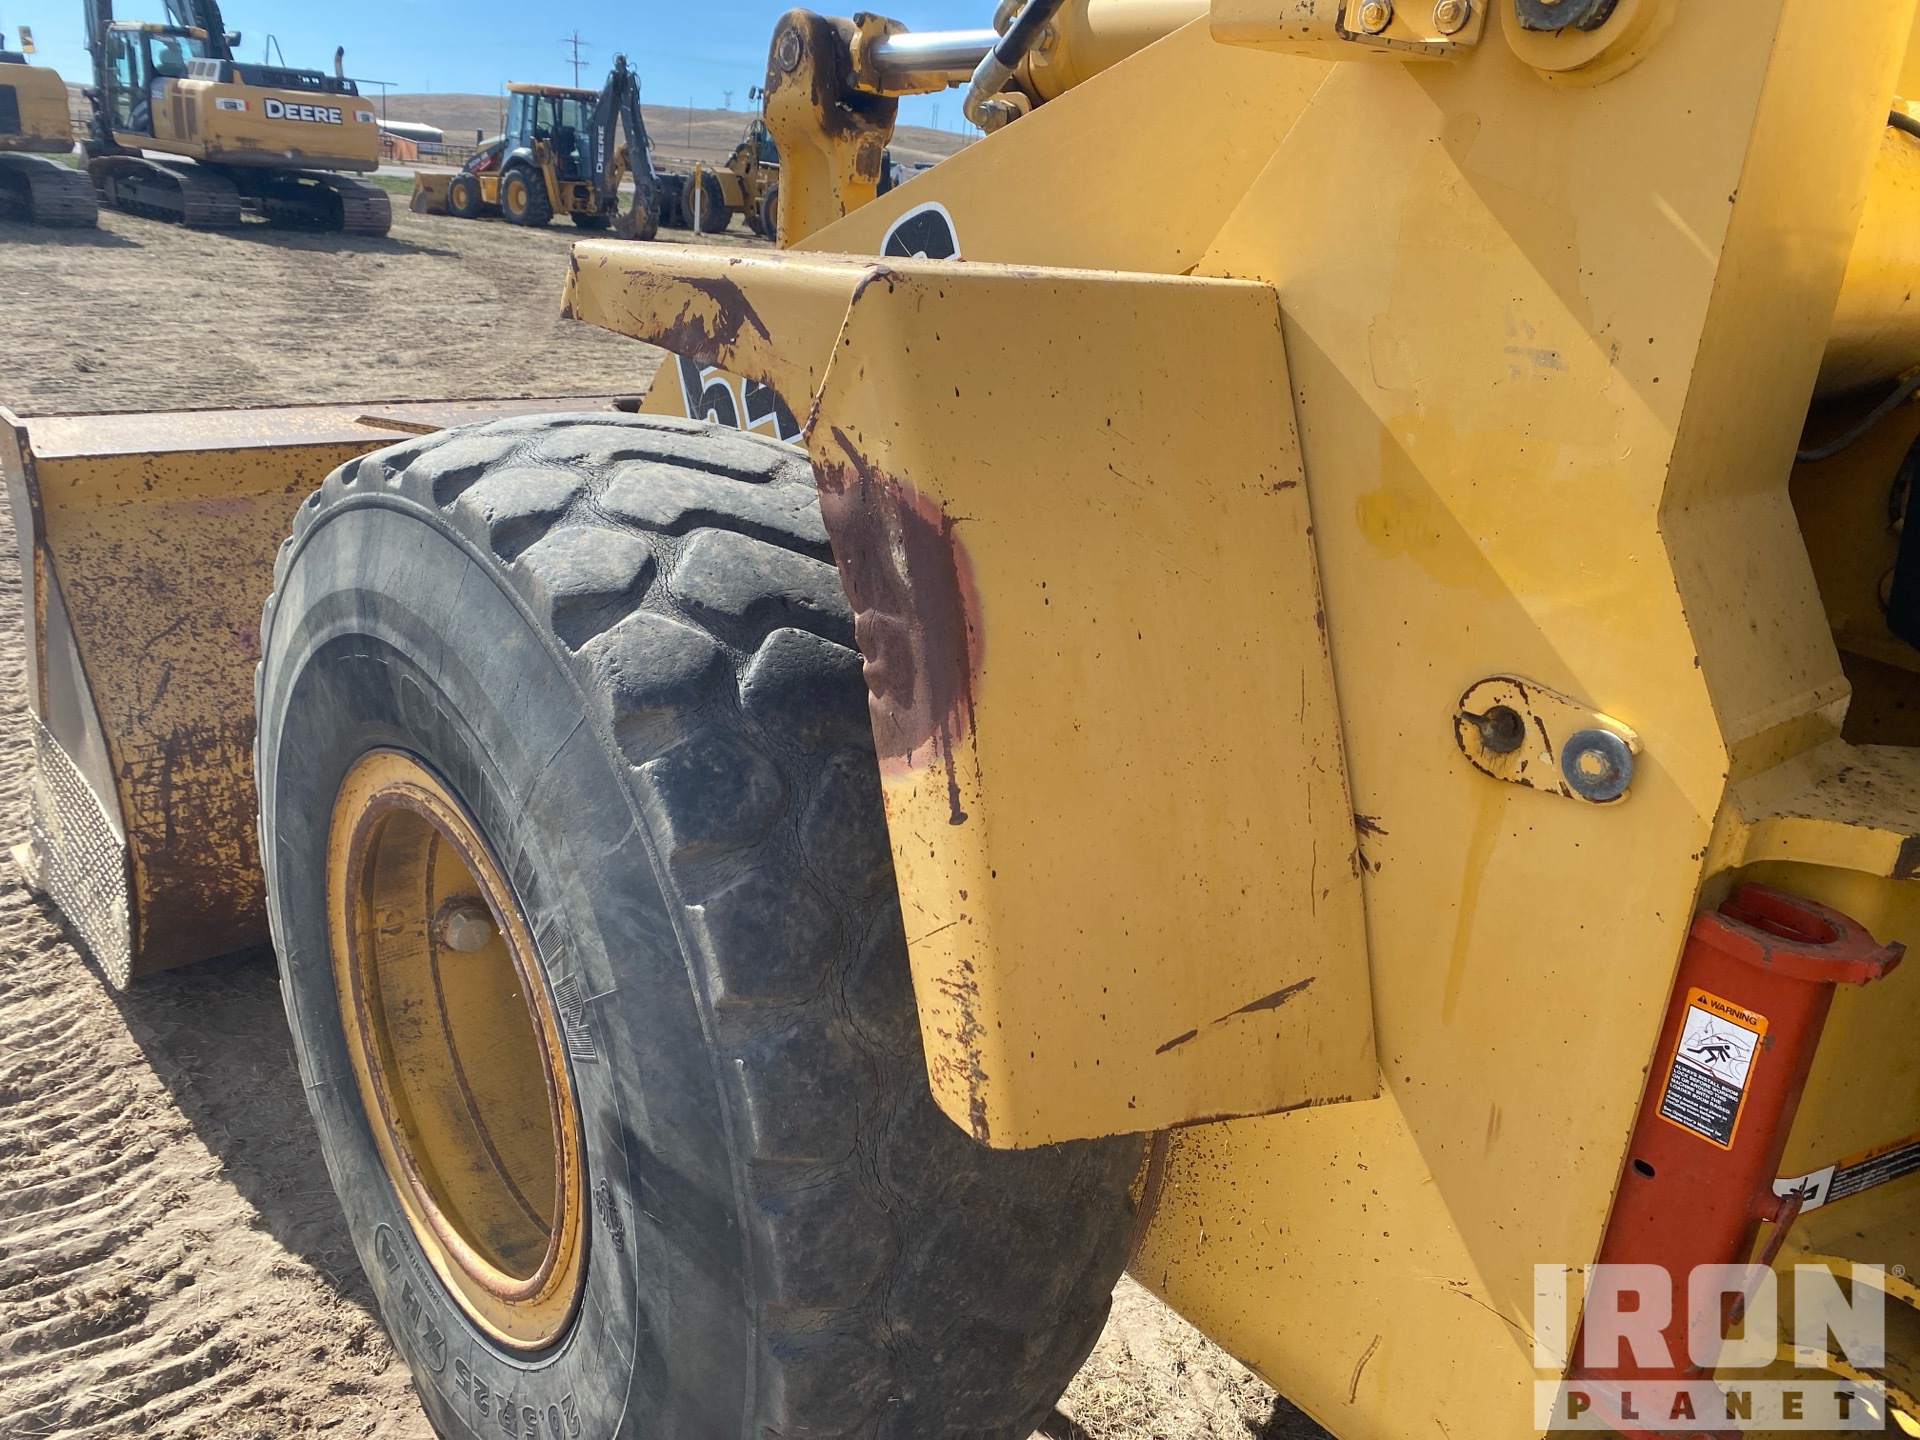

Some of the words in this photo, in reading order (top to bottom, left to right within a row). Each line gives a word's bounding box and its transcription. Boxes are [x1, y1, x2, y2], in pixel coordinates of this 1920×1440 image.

[264, 98, 343, 125] DEERE
[595, 124, 605, 174] DEERE
[1710, 1000, 1757, 1026] WARNING
[1670, 1078, 1695, 1092] MACHINE
[1695, 1089, 1710, 1099] WITH
[1673, 1068, 1688, 1078] LOCK
[1688, 1076, 1711, 1089] BEFORE
[1711, 1087, 1738, 1102] WORKING
[1674, 1064, 1697, 1077] ALWAYS
[1697, 1075, 1720, 1087] INSTALL
[1721, 1086, 1738, 1096] BOOM
[1690, 1082, 1714, 1095] AROUND
[1714, 1093, 1727, 1101] THIS
[1669, 1083, 1691, 1095] LOADER
[1692, 1093, 1709, 1104] BOOM
